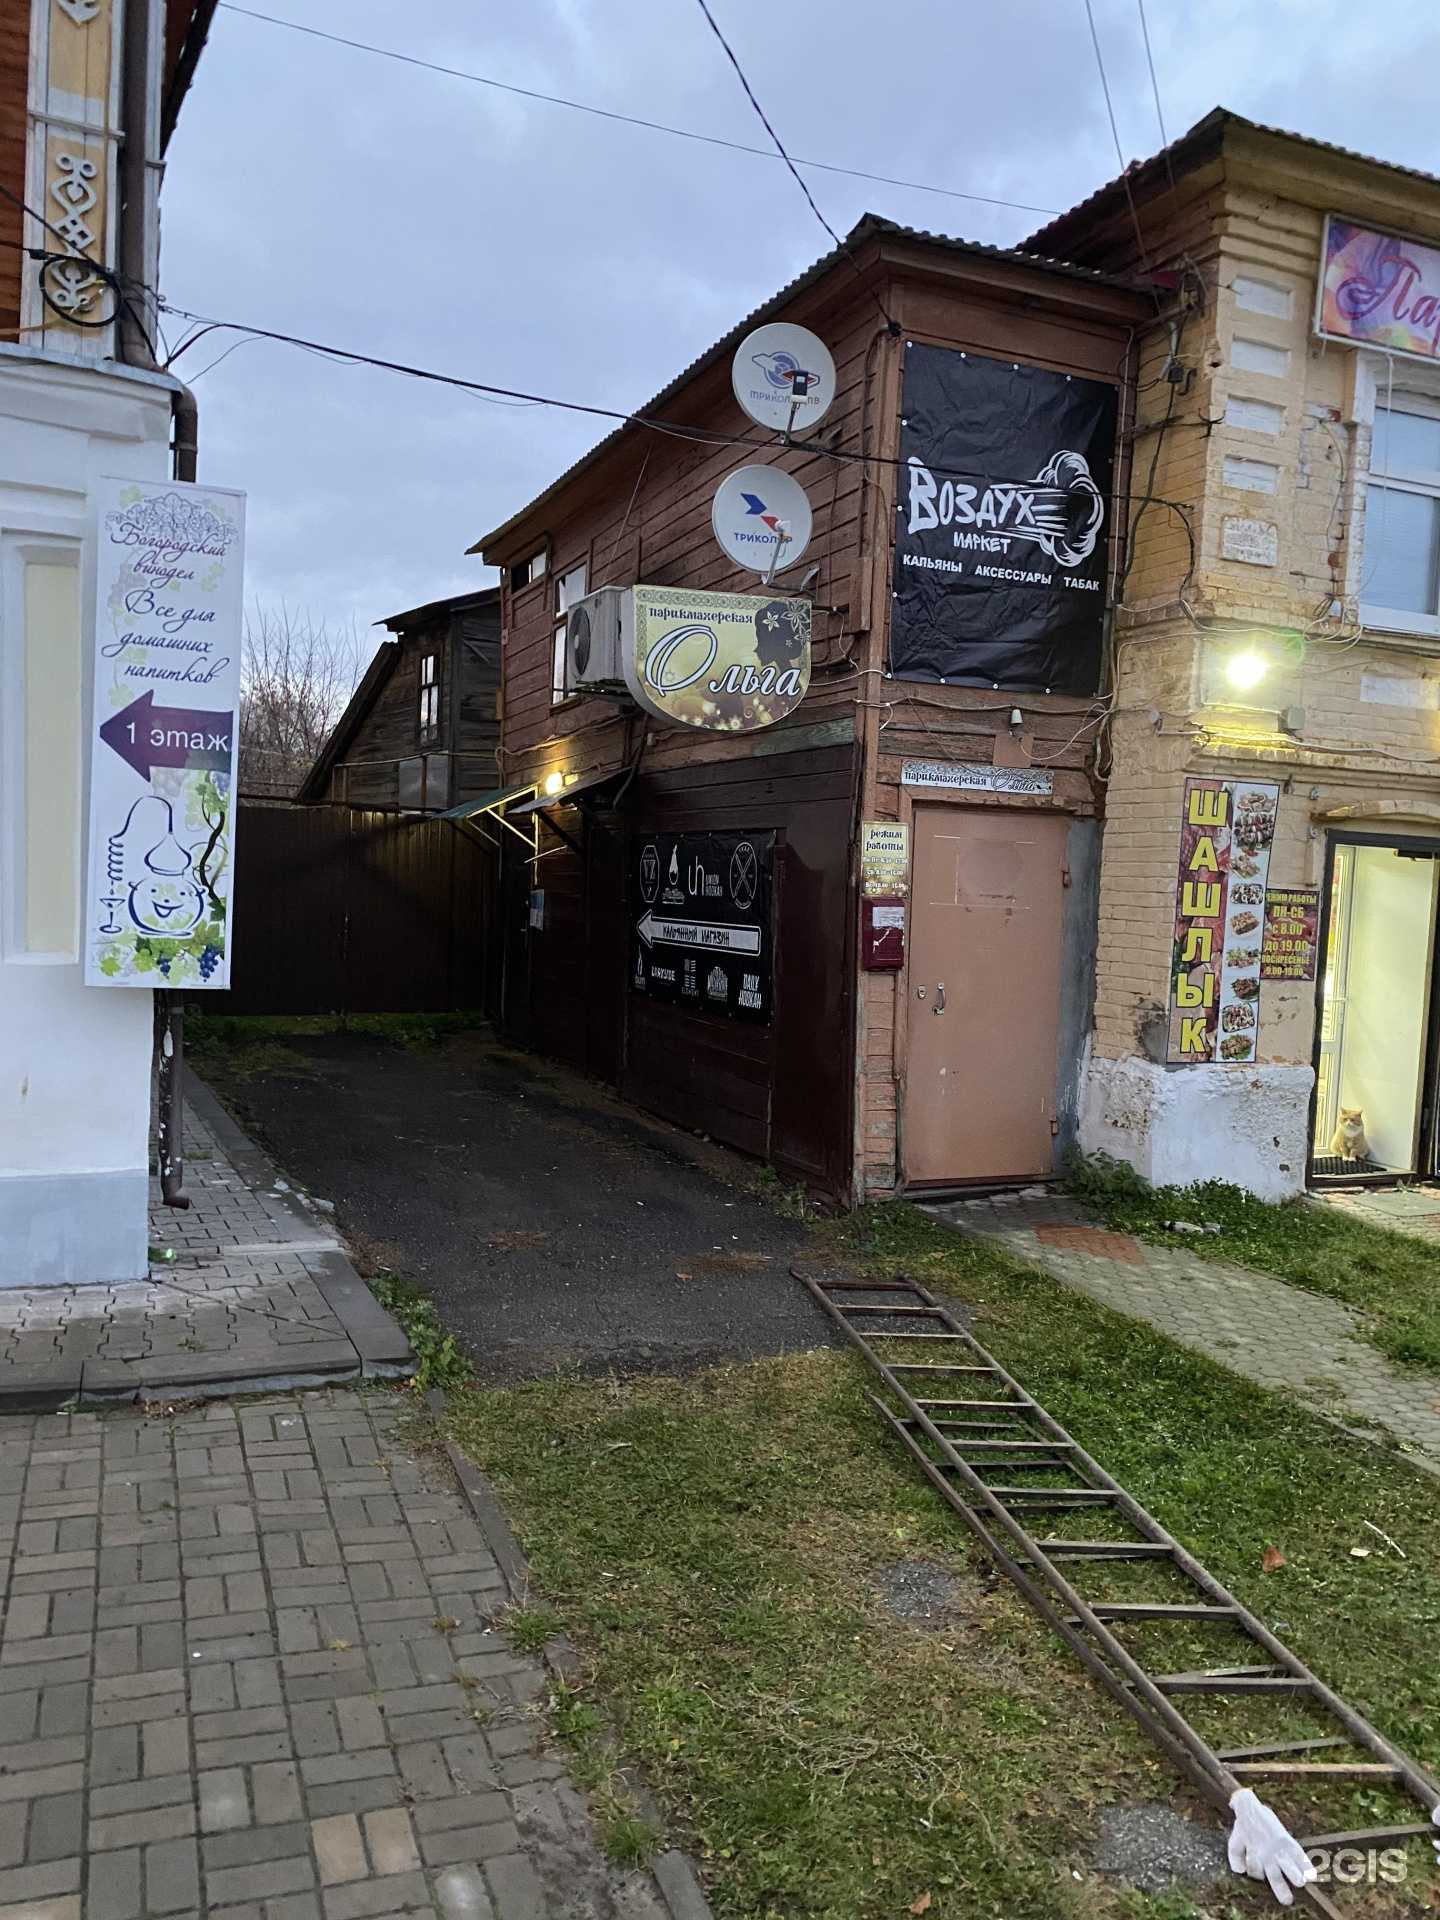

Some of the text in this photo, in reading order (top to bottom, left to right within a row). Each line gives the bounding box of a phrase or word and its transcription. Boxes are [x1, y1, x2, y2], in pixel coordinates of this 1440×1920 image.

[1336, 255, 1440, 353] Па
[750, 390, 797, 405] ТРИКОЛ
[110, 522, 231, 562] Богородский
[953, 532, 1011, 554] МАРКЕТ
[133, 551, 195, 588] винодел
[903, 554, 1100, 591] КАЛЬЯНЫ АКСЕССУАРЫ ТАБАК
[125, 587, 216, 633] Все для
[649, 607, 753, 624] парикмахерская
[101, 632, 214, 658] домашних
[124, 656, 230, 683] напитков
[645, 624, 801, 697] Ольга
[126, 722, 229, 752] 1 этаж
[905, 770, 987, 786] парикмахерская
[866, 841, 905, 852] работы
[871, 829, 903, 840] режим
[1176, 788, 1229, 1054] ШАШЛЫК
[1273, 905, 1304, 918] ПН-СБ
[1280, 922, 1303, 935] 8.00
[743, 973, 760, 991] DAILY
